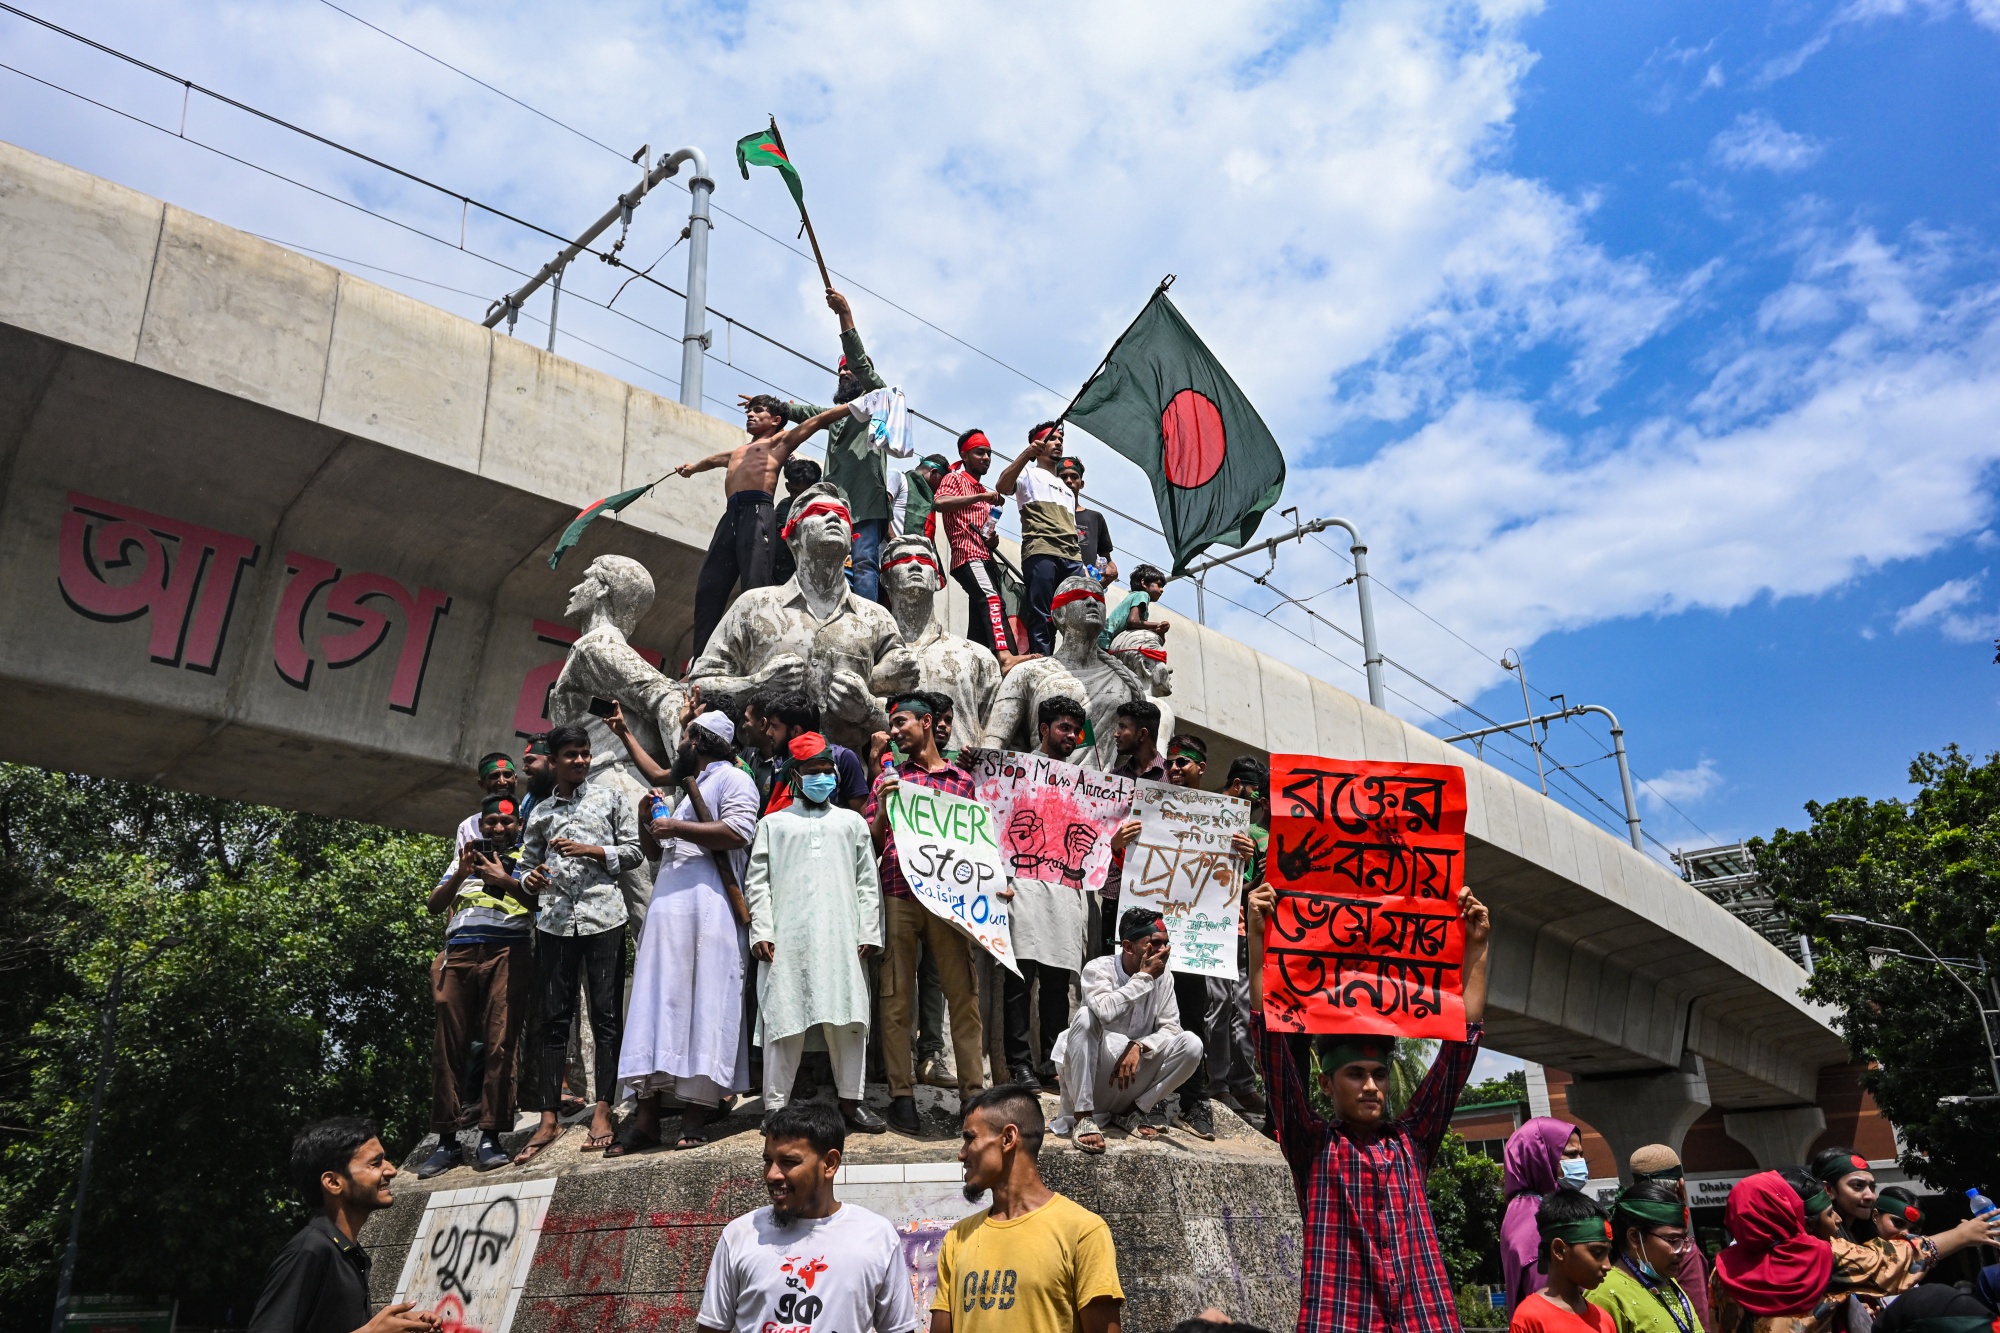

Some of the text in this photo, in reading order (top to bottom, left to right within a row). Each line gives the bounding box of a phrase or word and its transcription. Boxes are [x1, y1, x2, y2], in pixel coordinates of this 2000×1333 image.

[989, 602, 1007, 648] HUSTLE
[1034, 759, 1070, 786] Mass
[1074, 770, 1127, 802] Arrest
[1283, 768, 1447, 834] রক্তের
[889, 789, 997, 848] NEVER
[1333, 841, 1460, 900] বন্যায়
[908, 874, 1007, 926] Raising Our
[1272, 889, 1457, 957] ভেসে যাবে
[1267, 947, 1461, 1019] অন্যায়
[1691, 1195, 1729, 1205] Univer
[1699, 1182, 1733, 1192] Dhaka
[773, 1293, 824, 1325] এক
